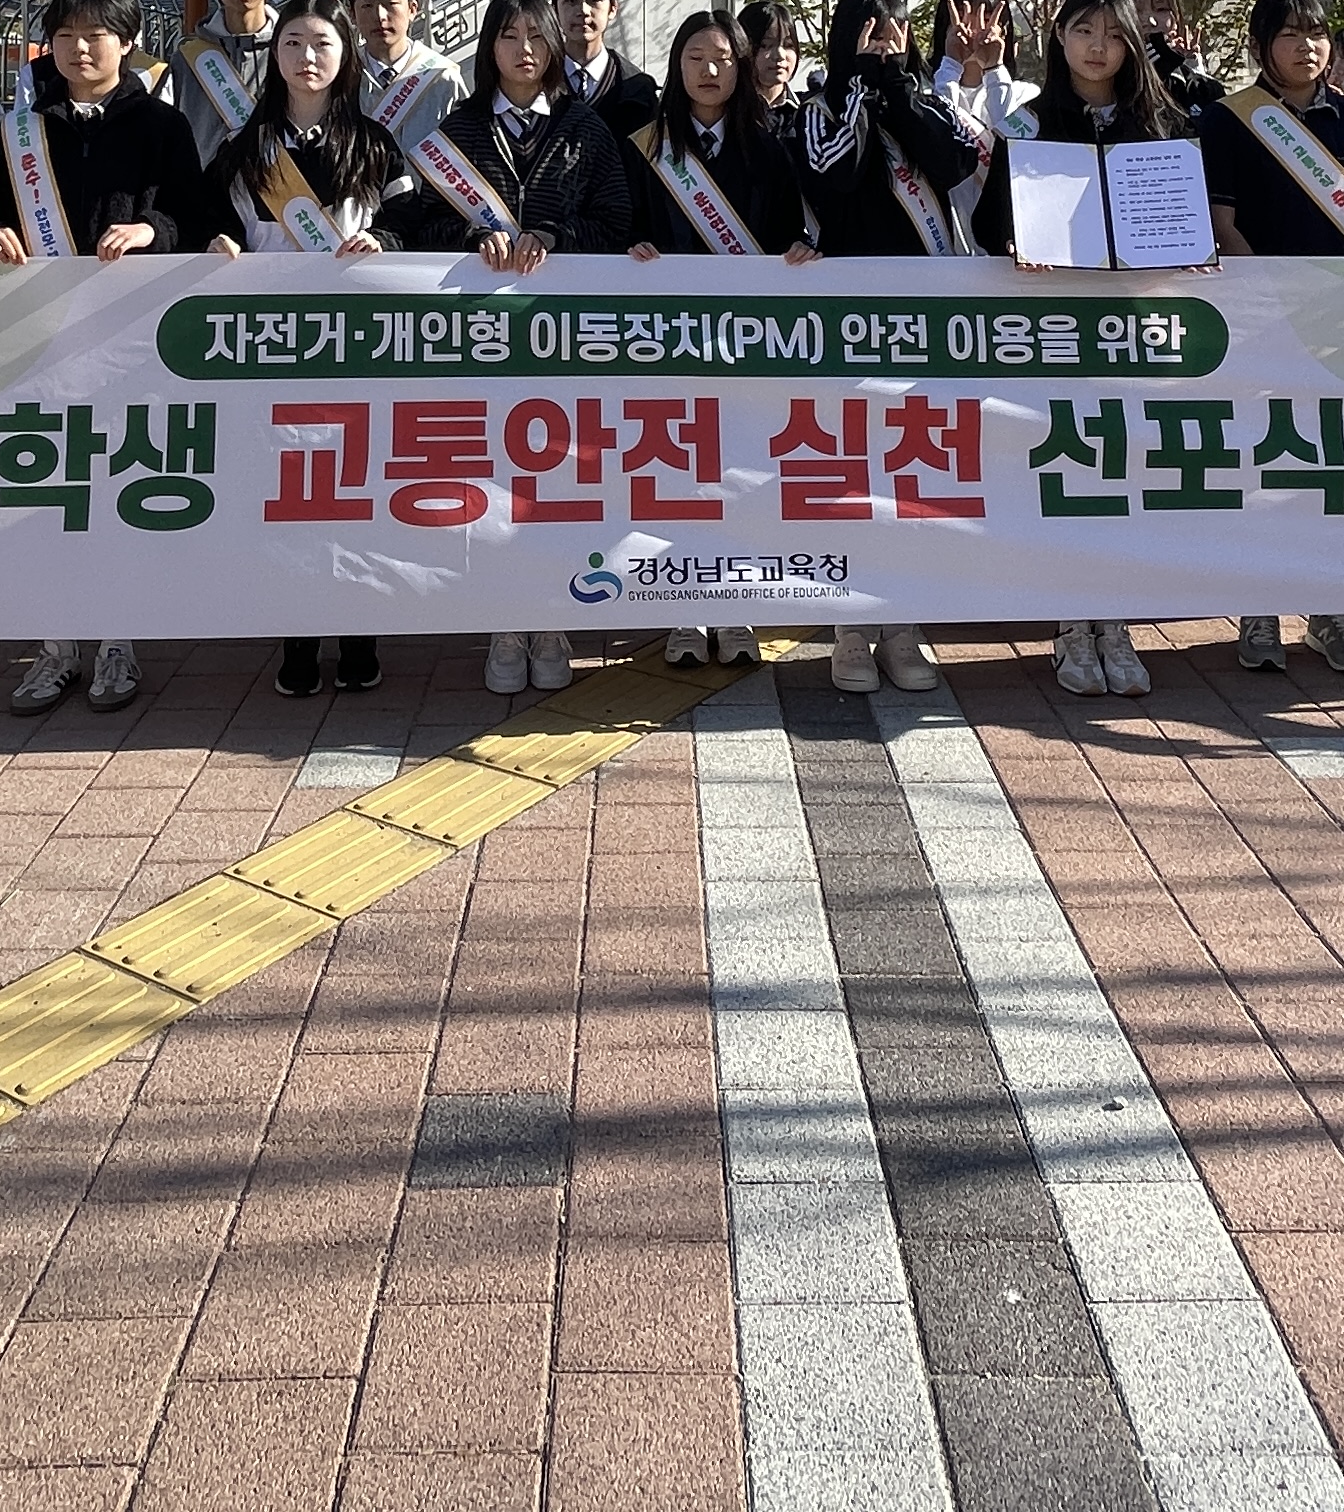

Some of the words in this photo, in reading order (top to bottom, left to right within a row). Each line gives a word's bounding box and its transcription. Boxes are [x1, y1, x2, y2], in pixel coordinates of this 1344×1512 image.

[21, 152, 42, 204] 준수!
[203, 309, 513, 366] 자전거·개인형
[528, 309, 825, 366] 이동장치(PM)
[841, 311, 931, 366] 안전
[947, 311, 1082, 366] 이용을
[1095, 311, 1188, 365] 위한
[262, 396, 725, 528] 교통안전
[768, 395, 987, 522] 실천
[627, 553, 849, 586] 경상남도교육청
[627, 589, 740, 603] GYEONGSANGNAMDO
[741, 588, 776, 601] OFFICE
[777, 587, 791, 600] OF
[792, 585, 851, 600] EDUCATION
